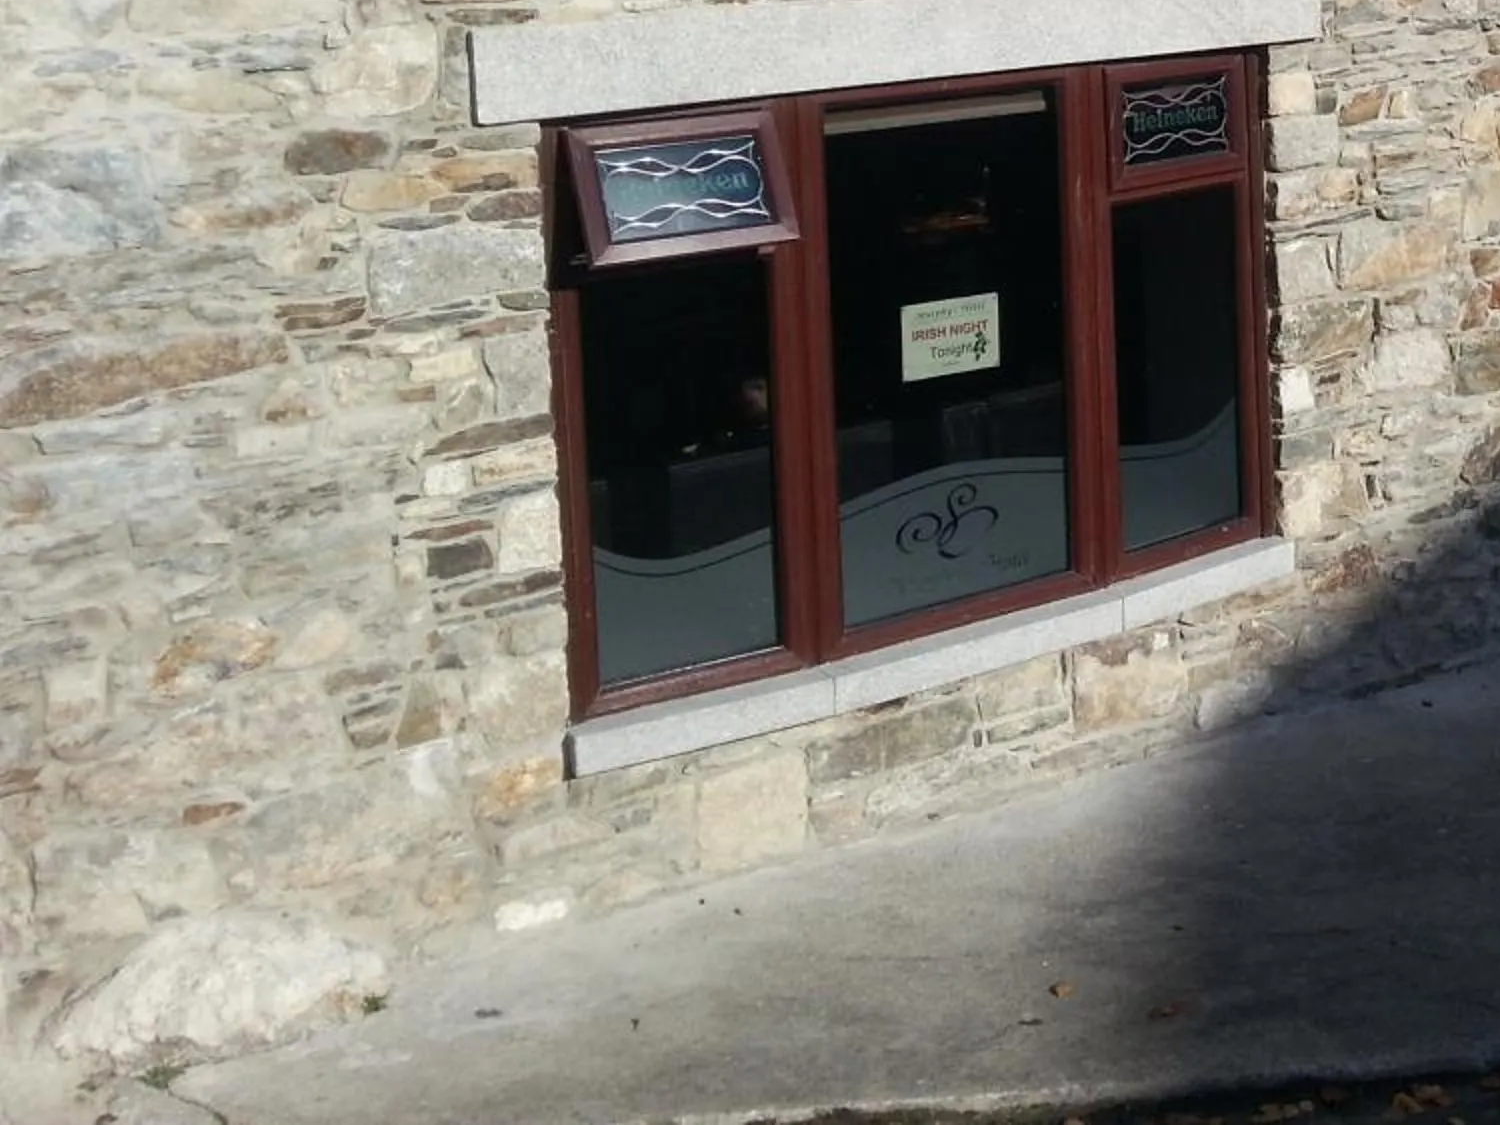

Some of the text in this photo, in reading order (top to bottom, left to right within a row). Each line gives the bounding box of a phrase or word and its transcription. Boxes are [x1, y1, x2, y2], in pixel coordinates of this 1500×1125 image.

[1132, 104, 1219, 132] Heineken
[912, 319, 988, 342] IRISH NIGHT
